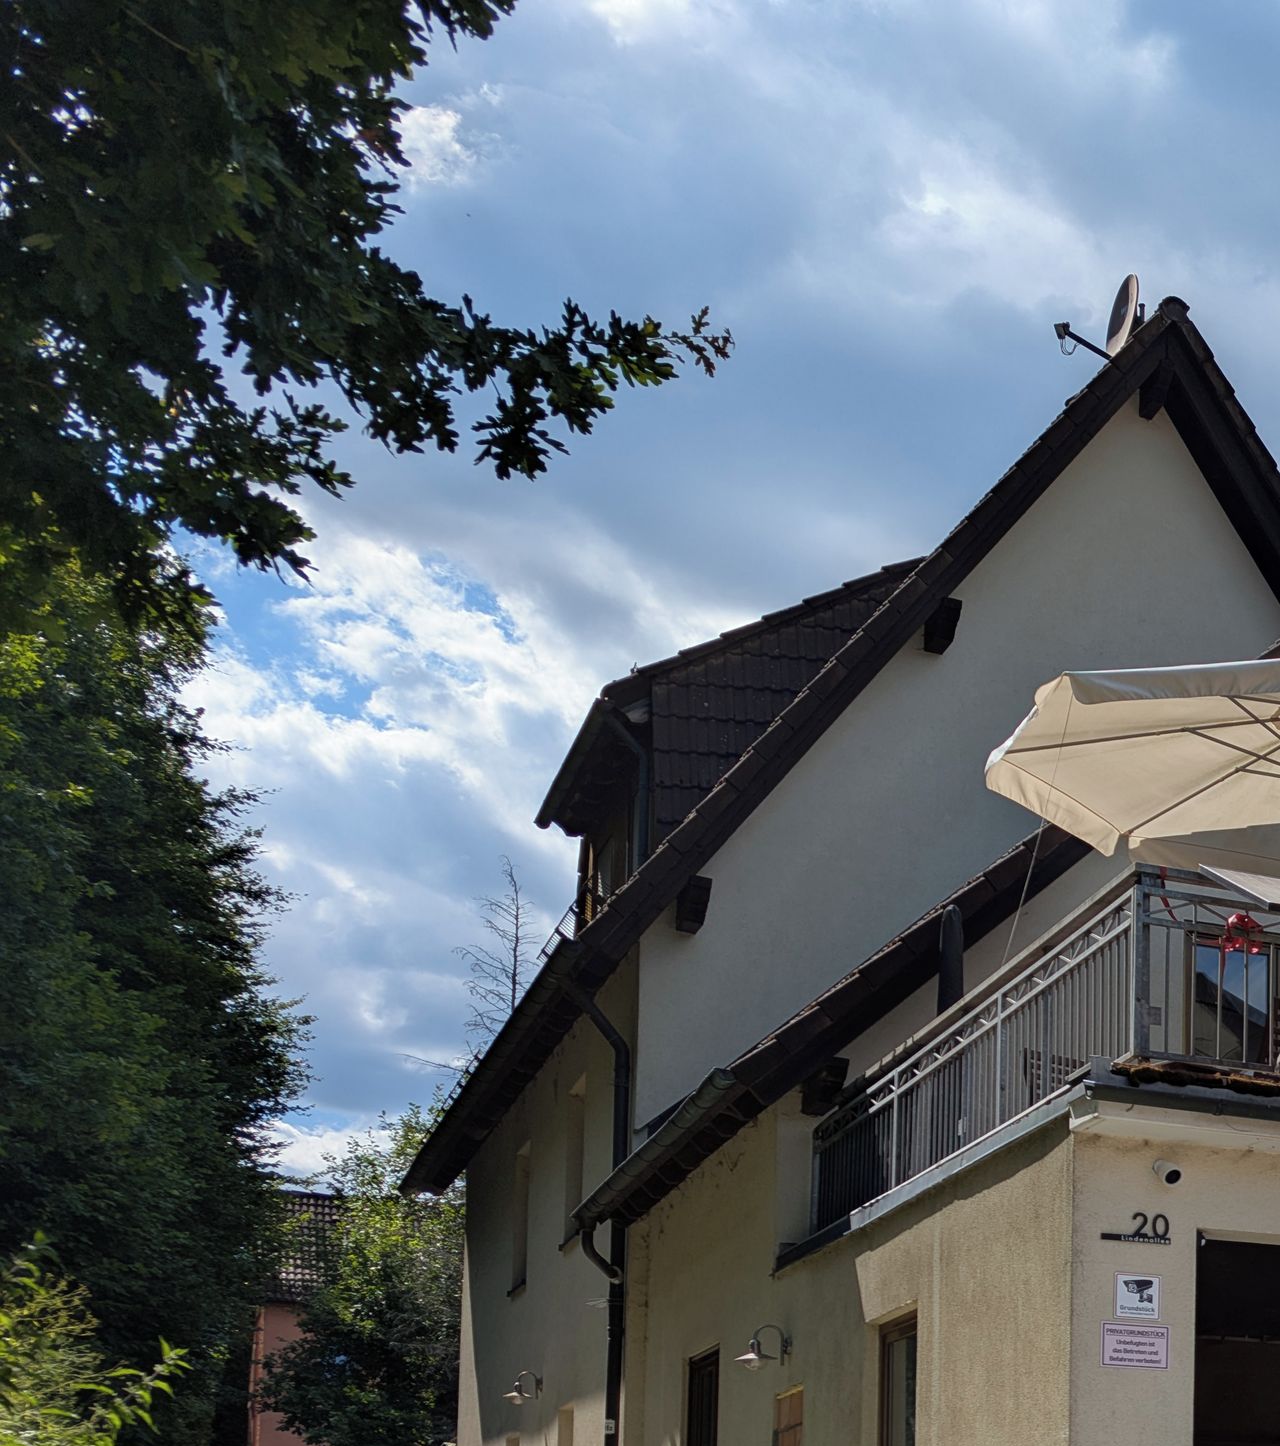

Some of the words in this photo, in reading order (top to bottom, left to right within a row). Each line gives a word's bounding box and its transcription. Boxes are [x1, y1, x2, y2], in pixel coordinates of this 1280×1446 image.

[1132, 1212, 1169, 1237] 20
[1121, 1235, 1169, 1244] Lindenallee
[1105, 1328, 1165, 1337] PRIVATGRUNDSTÜCK
